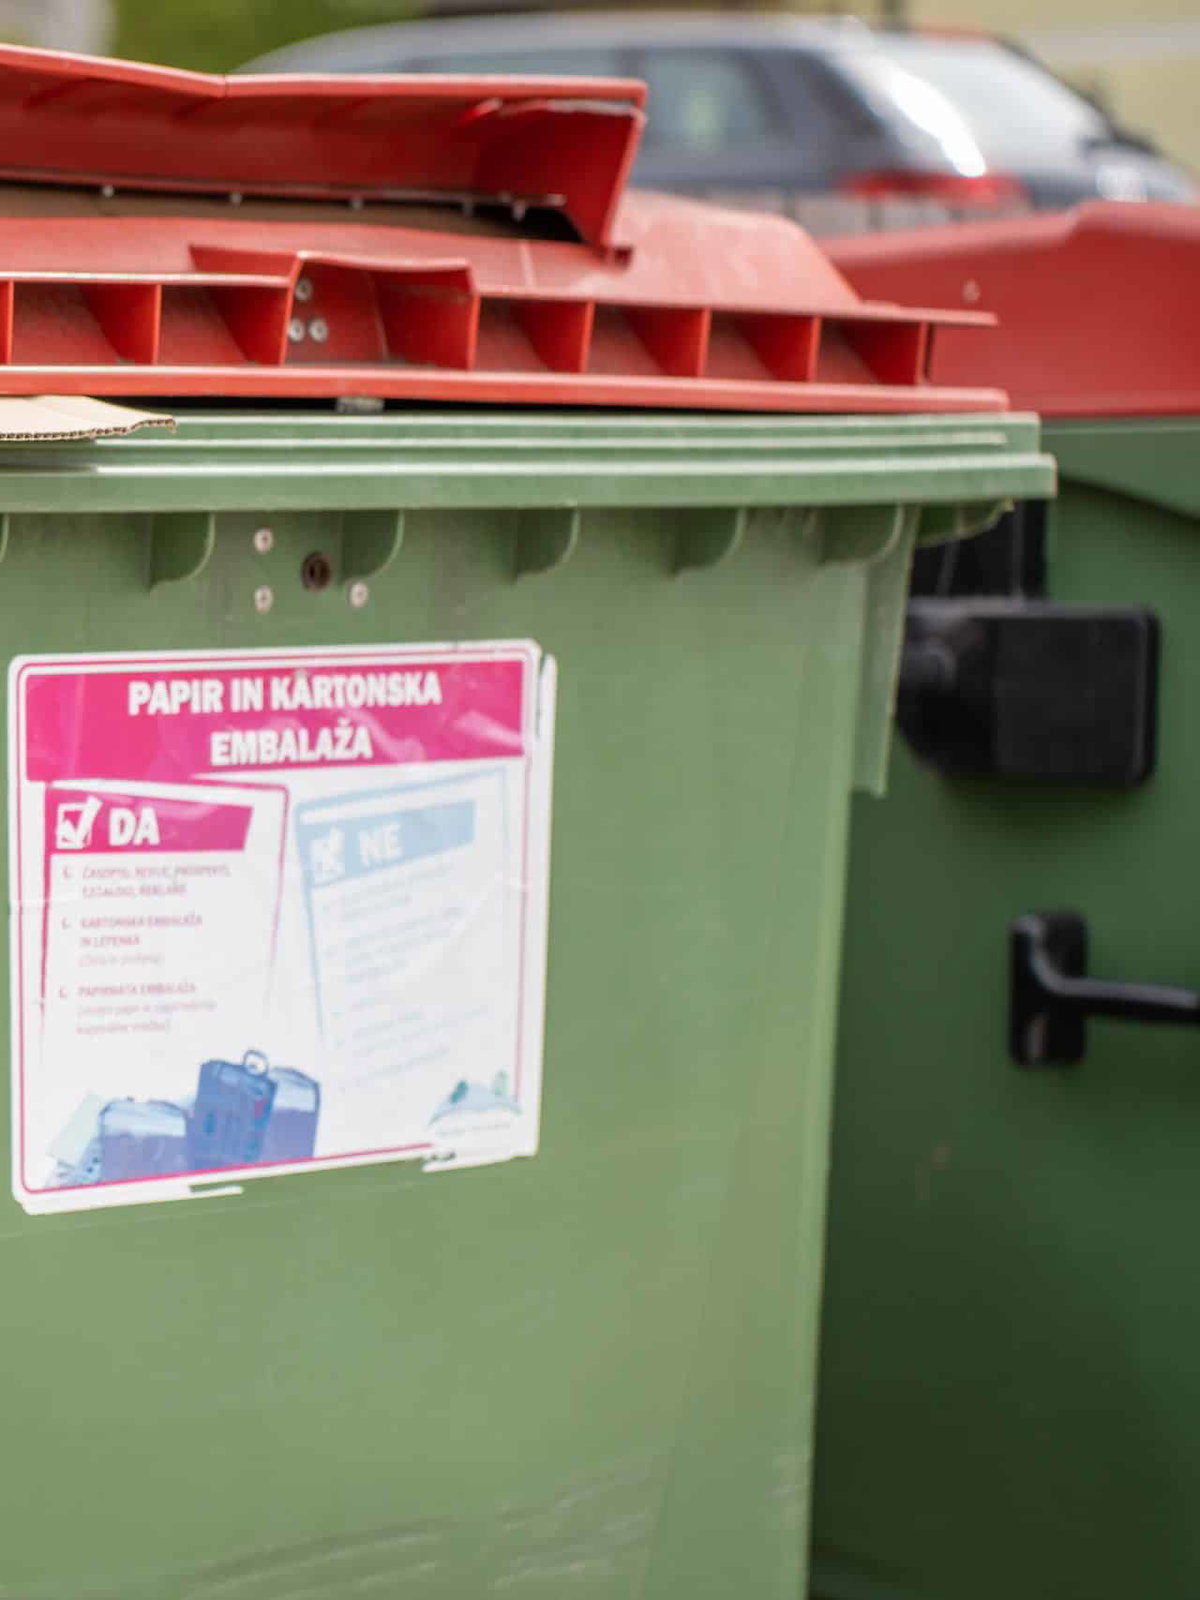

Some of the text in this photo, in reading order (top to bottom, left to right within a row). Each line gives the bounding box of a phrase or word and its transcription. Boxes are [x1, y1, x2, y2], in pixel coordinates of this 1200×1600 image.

[128, 671, 442, 715] PAPIR IN KARTONSKA
[210, 719, 373, 765] EMBALAŽA
[109, 808, 160, 845] DA
[358, 827, 402, 864] NE
